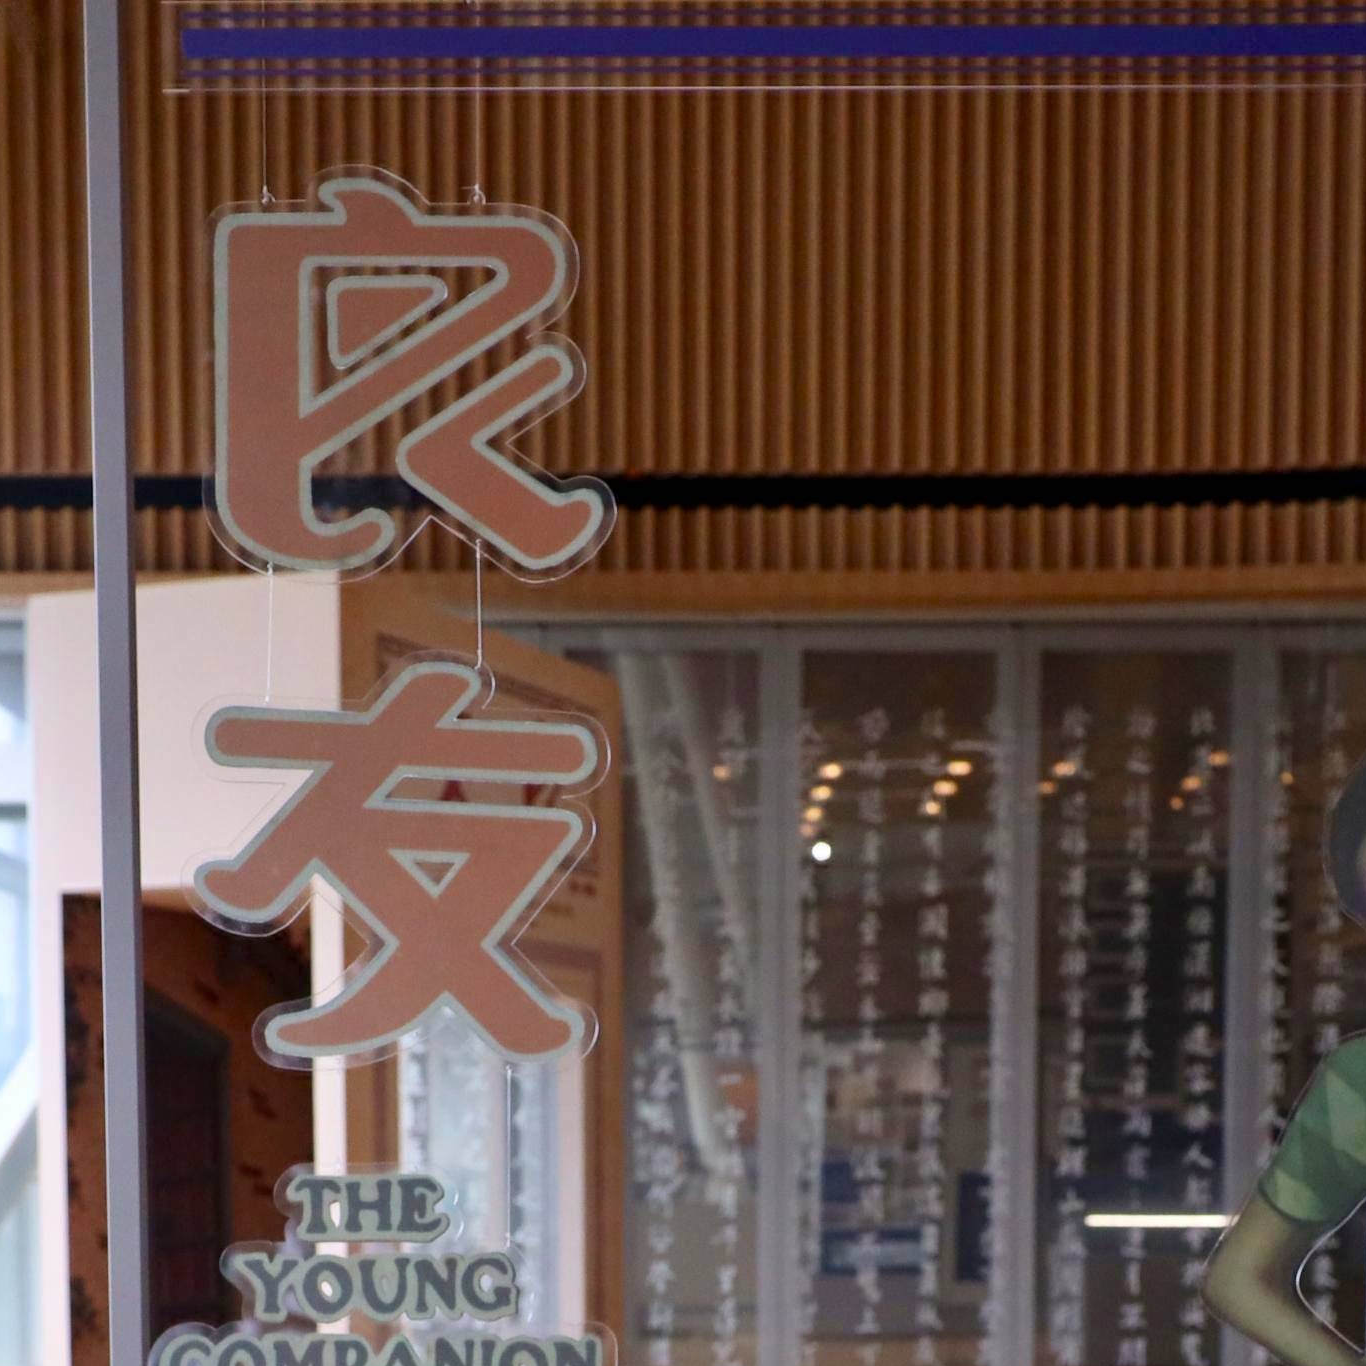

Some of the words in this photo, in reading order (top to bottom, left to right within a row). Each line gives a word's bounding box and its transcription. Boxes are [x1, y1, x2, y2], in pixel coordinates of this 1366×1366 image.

[194, 177, 604, 1063] 良友
[295, 1176, 446, 1235] THE
[242, 1252, 515, 1316] YOUNG
